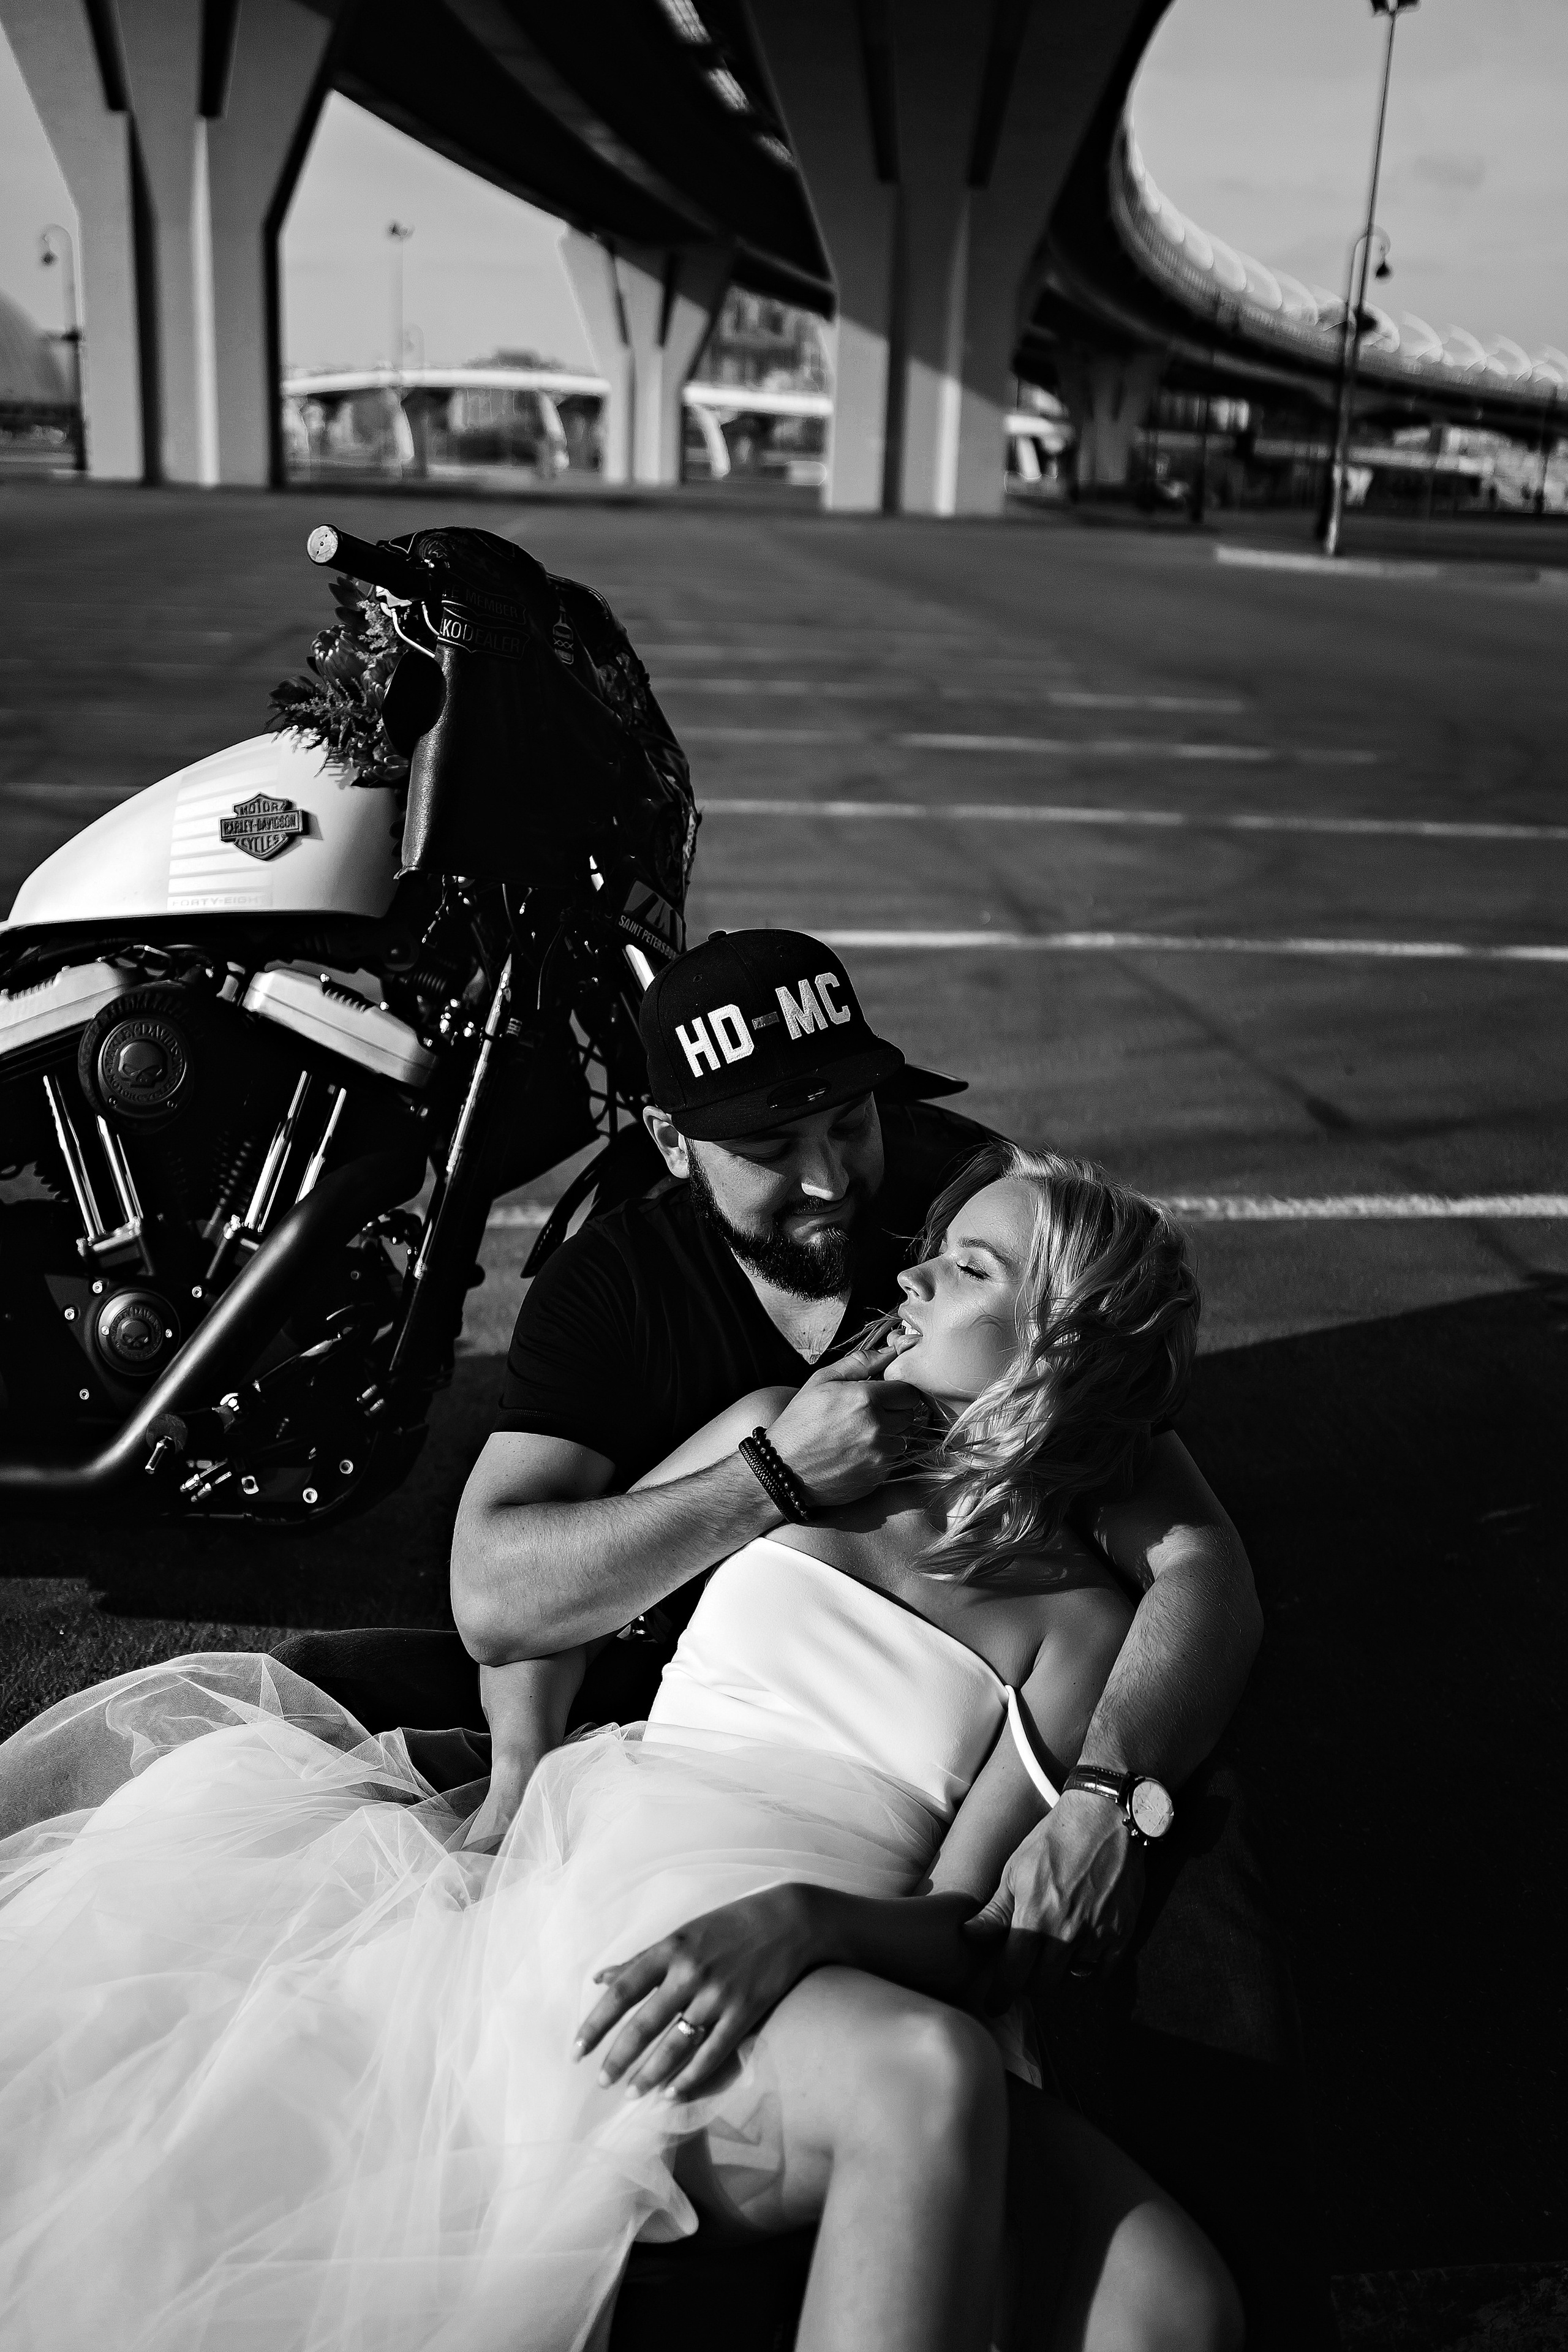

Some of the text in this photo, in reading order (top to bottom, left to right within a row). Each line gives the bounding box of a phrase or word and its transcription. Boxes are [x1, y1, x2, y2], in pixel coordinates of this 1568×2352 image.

[466, 588, 518, 619] MEMBER
[239, 798, 279, 816] MOTOR
[224, 815, 296, 835] HARLEY-DAVIDSON
[240, 834, 281, 853] CYCLES
[618, 914, 644, 937] SAINT
[675, 972, 851, 1078] HD-MC
